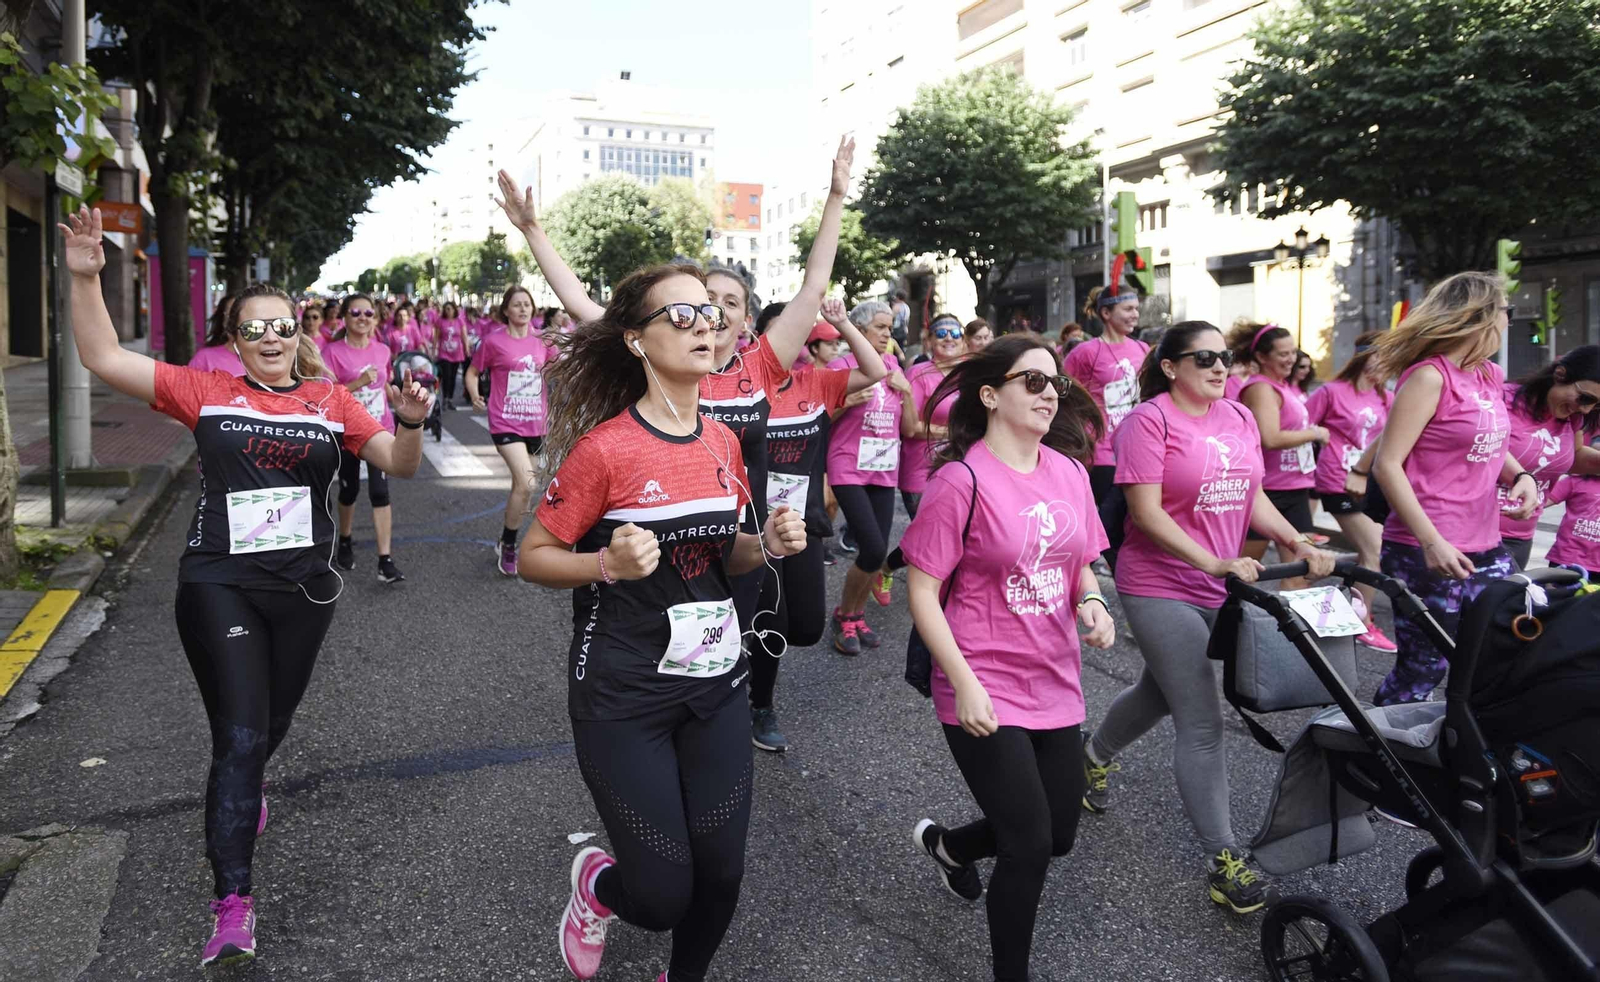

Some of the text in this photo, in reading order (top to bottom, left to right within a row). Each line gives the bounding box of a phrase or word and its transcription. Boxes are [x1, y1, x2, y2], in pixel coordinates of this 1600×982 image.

[220, 420, 331, 443] CUATRECASAS
[778, 488, 790, 499] 22
[1200, 478, 1250, 495] CARRERA
[1197, 490, 1246, 504] FEMENINA
[266, 508, 282, 524] 21
[702, 626, 723, 646] 299
